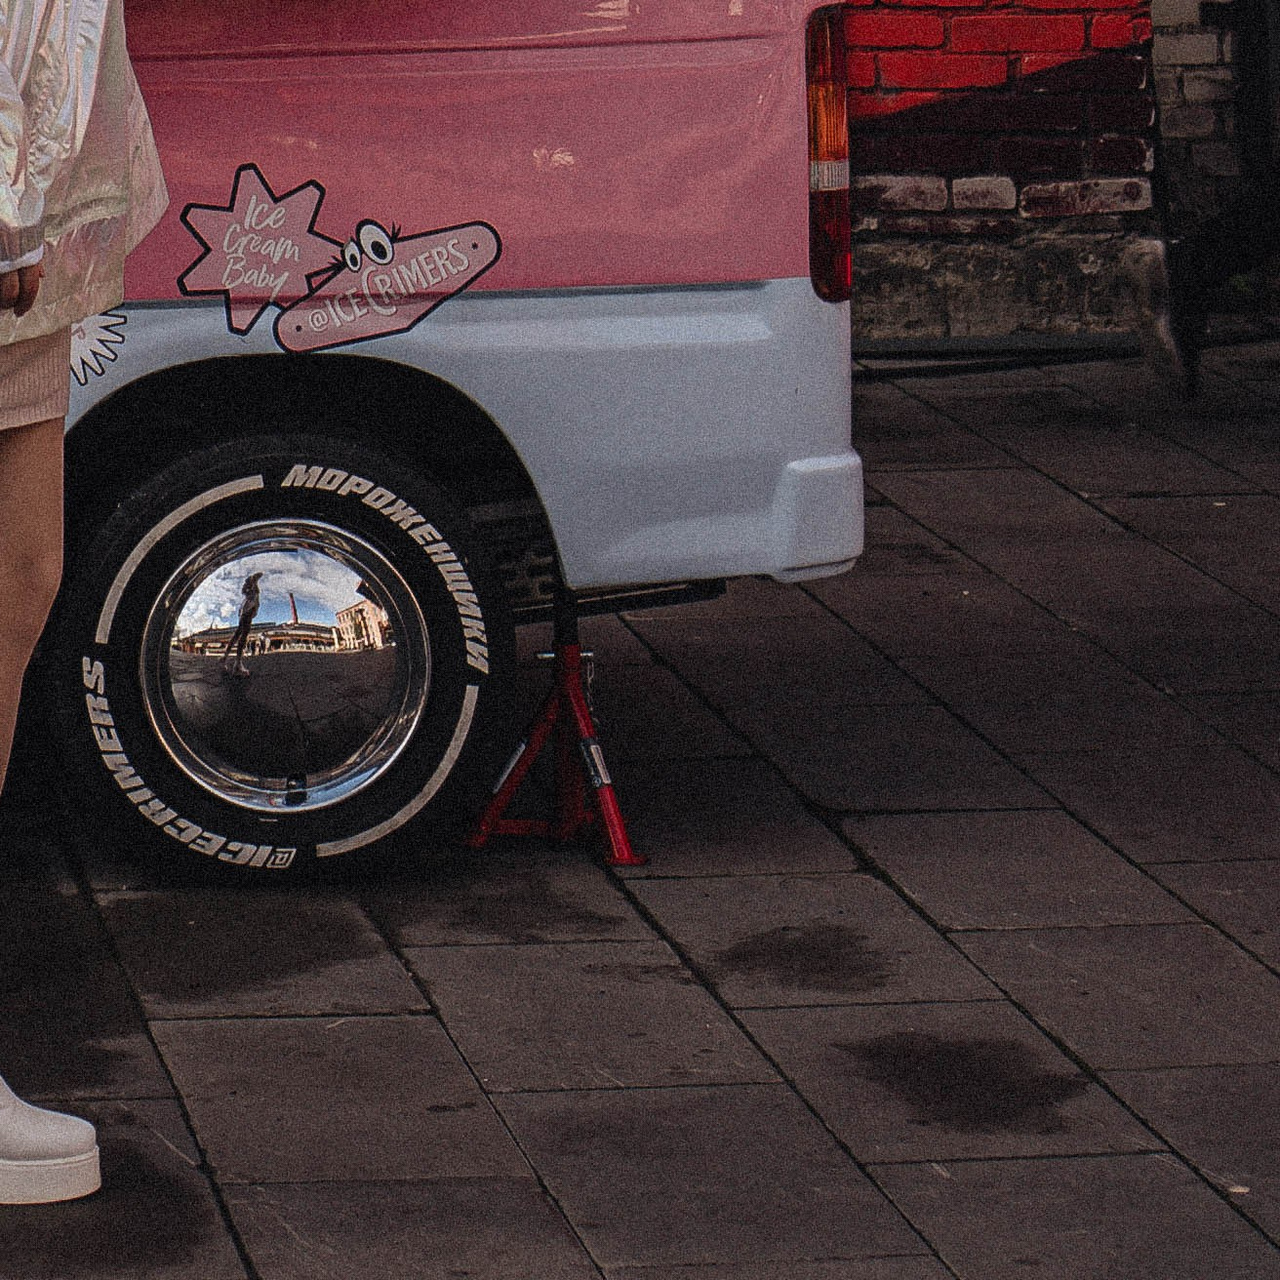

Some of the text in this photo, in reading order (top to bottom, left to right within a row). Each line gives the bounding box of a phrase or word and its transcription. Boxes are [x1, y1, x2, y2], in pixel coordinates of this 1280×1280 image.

[244, 195, 286, 231] Ice
[223, 223, 301, 264] Cream
[221, 254, 290, 298] Baby
[281, 464, 489, 674] МОРОЖЕНЩИКИ
